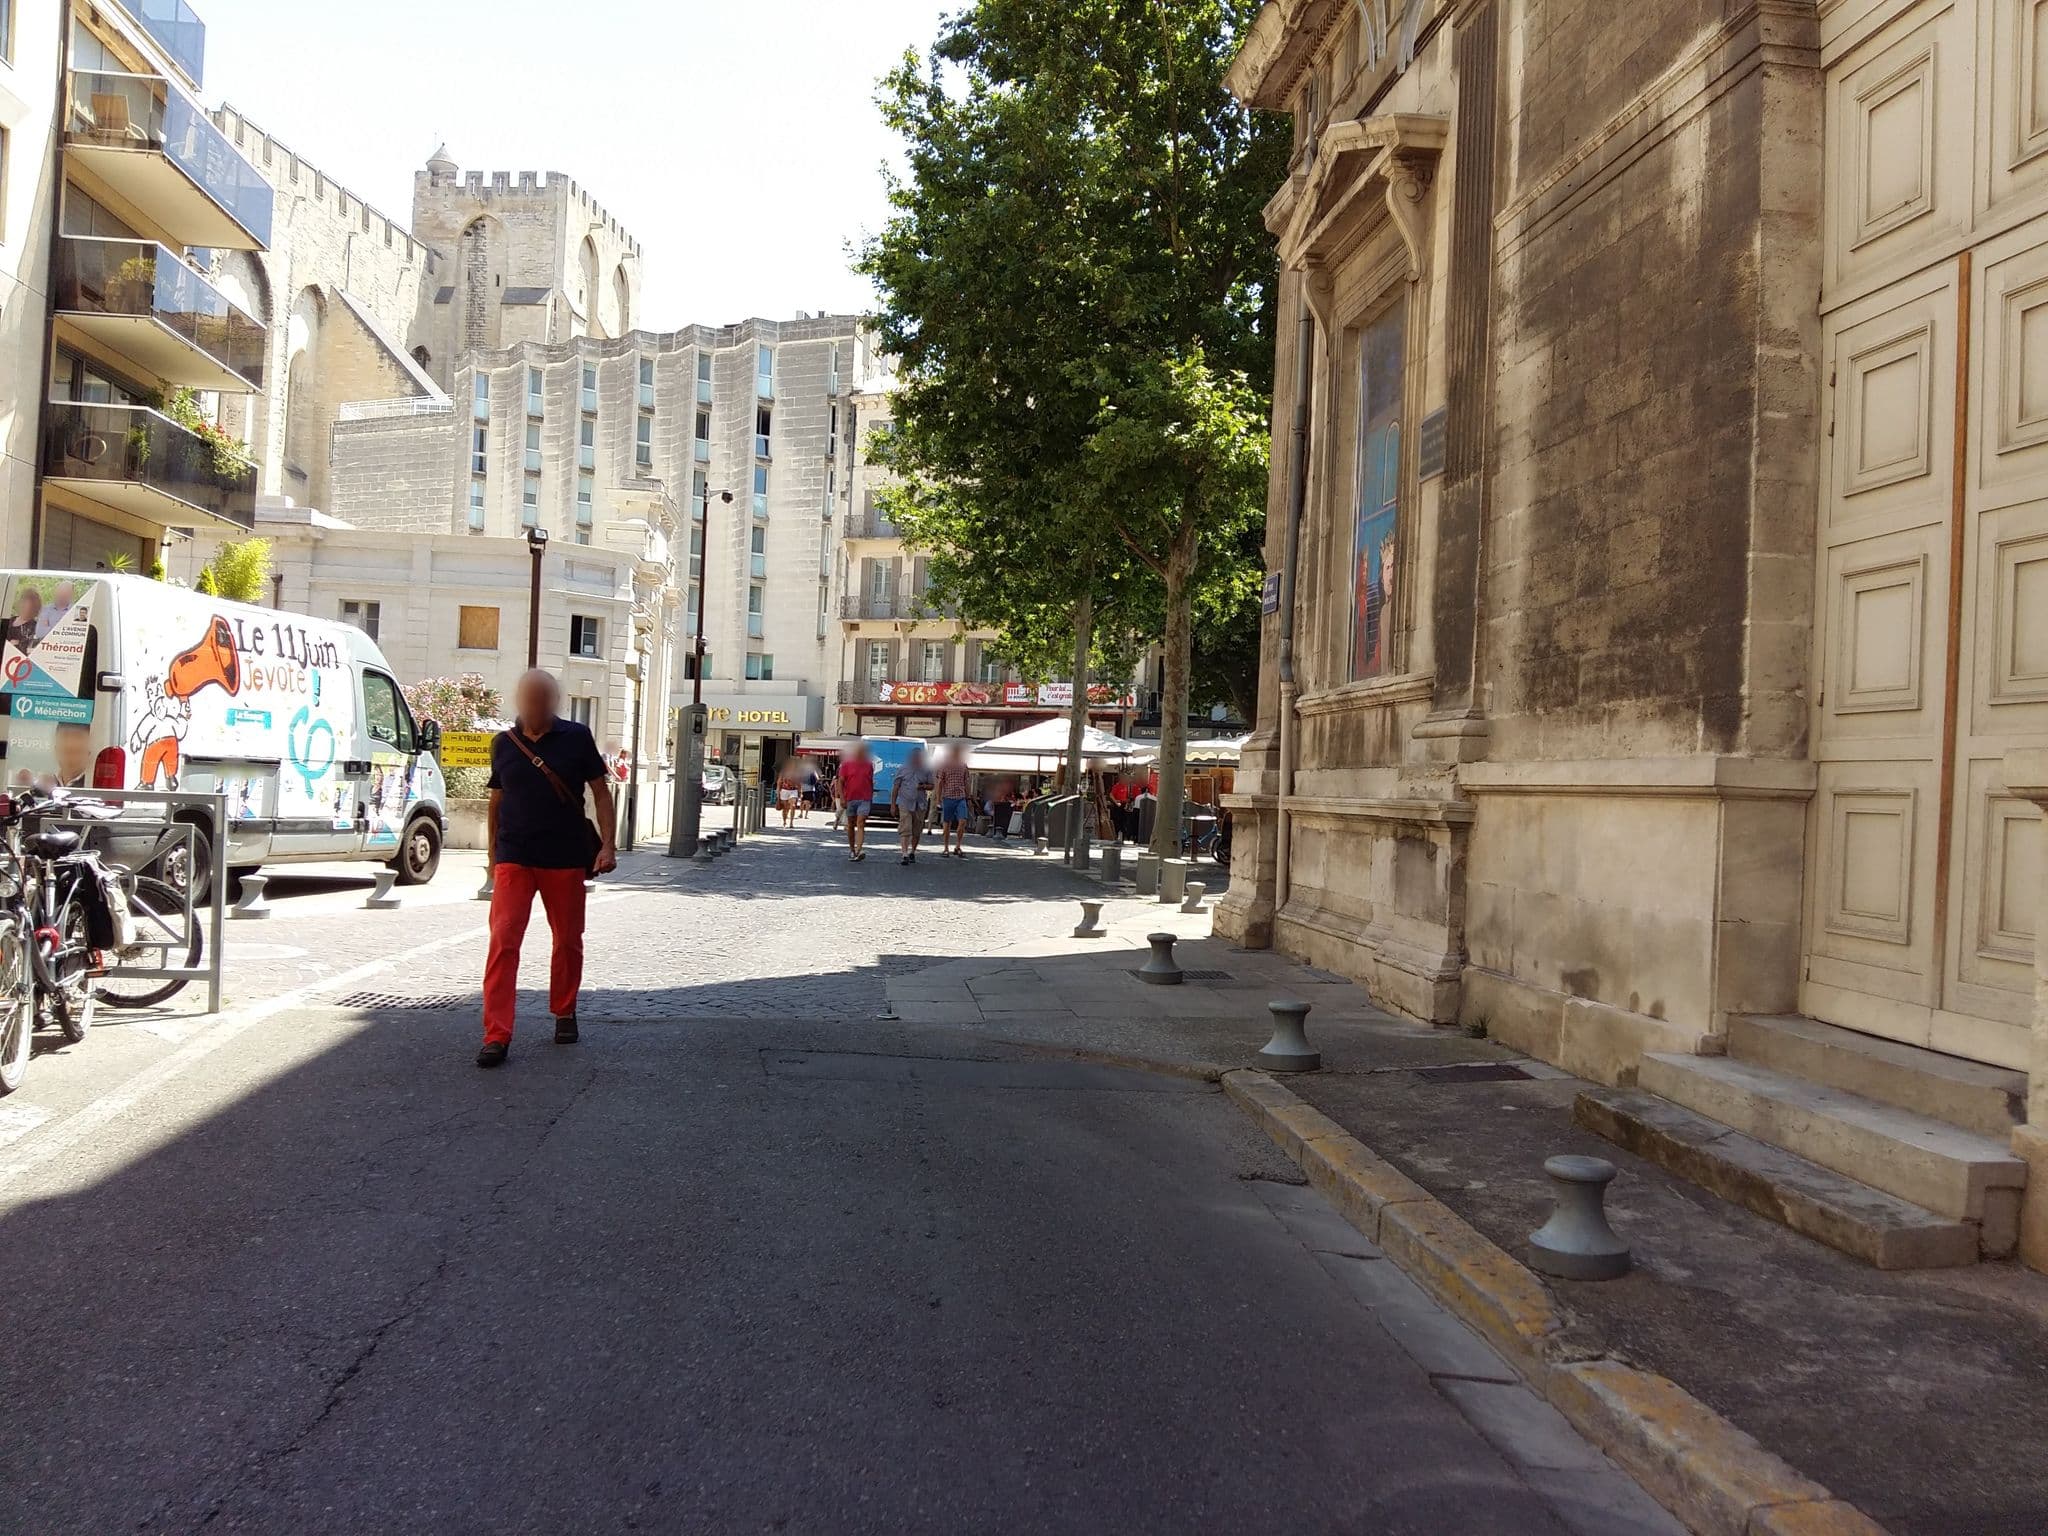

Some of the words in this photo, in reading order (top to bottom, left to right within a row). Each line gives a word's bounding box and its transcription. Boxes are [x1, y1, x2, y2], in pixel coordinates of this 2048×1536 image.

[234, 618, 264, 656] Le
[41, 642, 84, 653] Thérond
[34, 706, 86, 718] Mélenchon
[737, 710, 790, 724] HOTEL
[458, 735, 482, 743] KYRIAD
